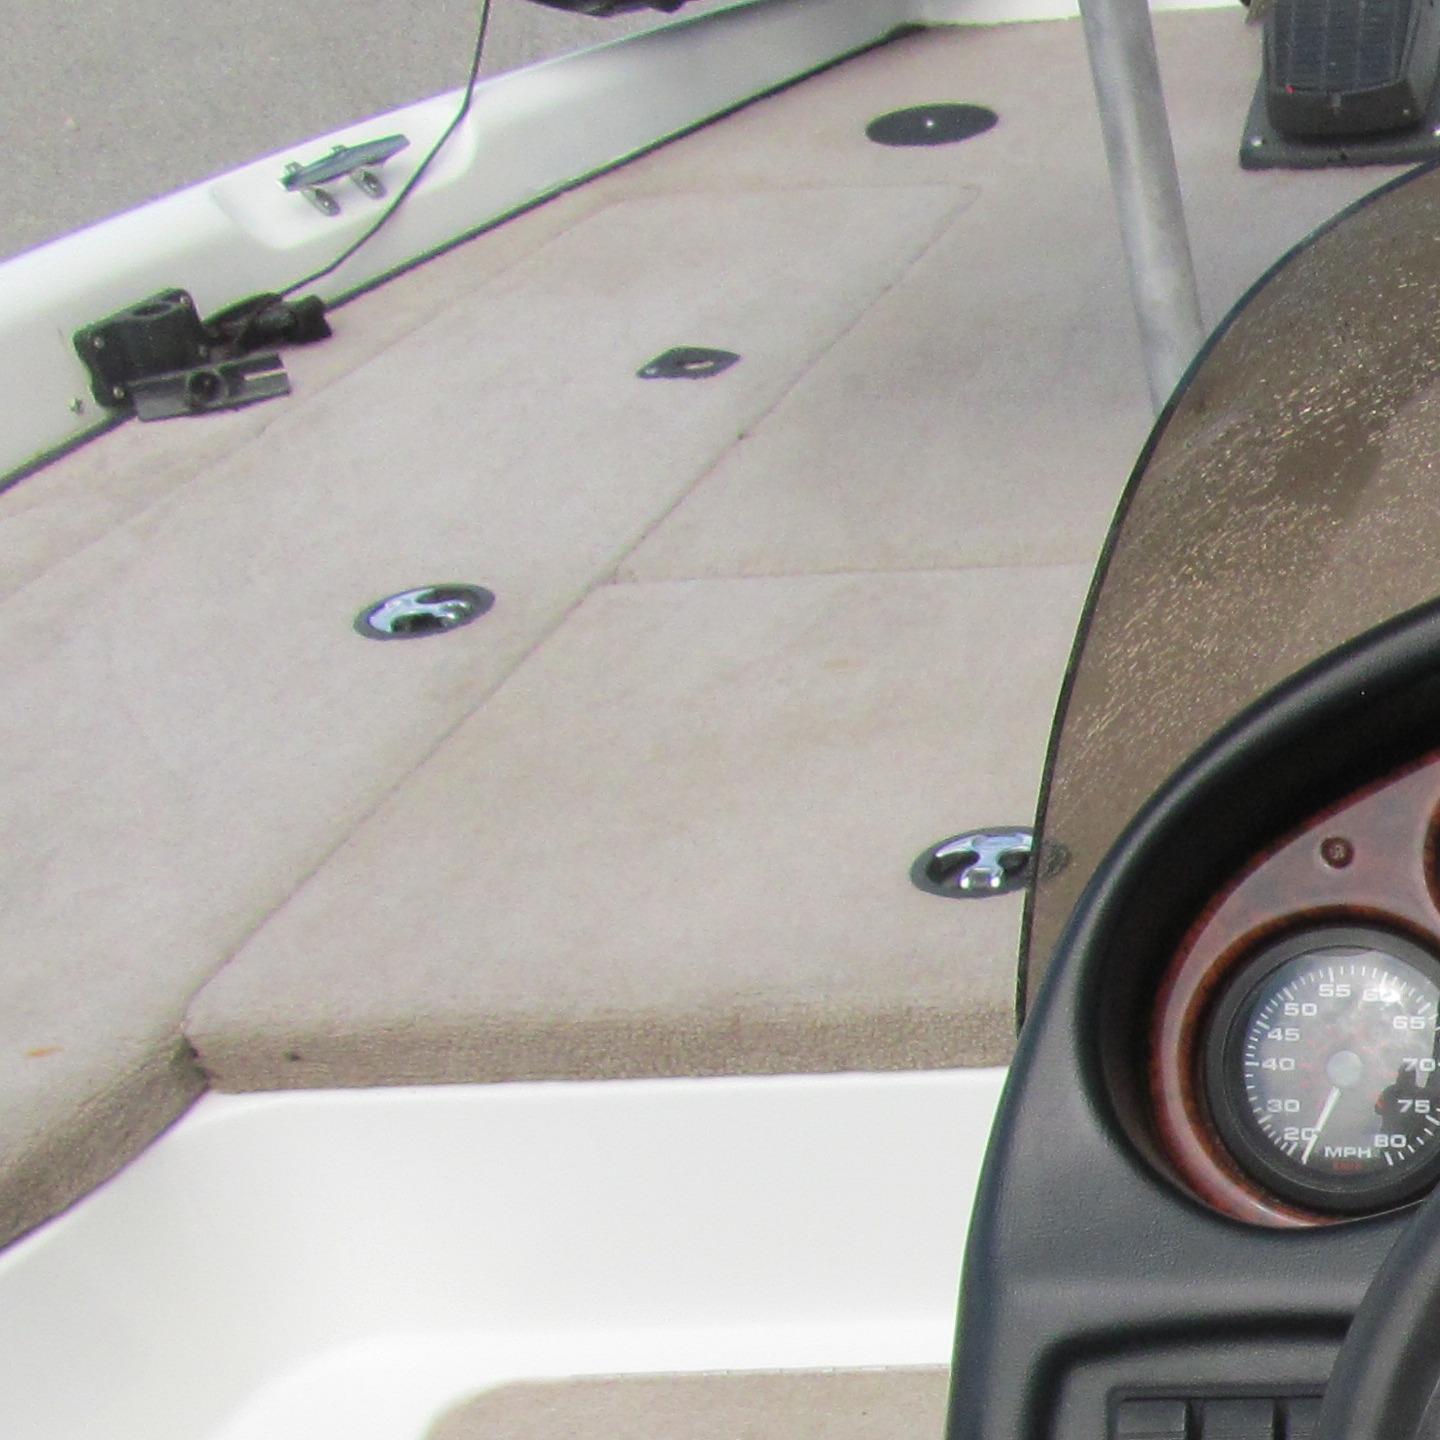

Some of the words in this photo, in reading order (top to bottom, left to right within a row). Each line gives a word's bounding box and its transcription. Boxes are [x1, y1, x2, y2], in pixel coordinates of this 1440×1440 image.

[1318, 984, 1351, 998] 55
[1284, 1003, 1317, 1017] 50
[1392, 1016, 1426, 1030] 65
[1267, 1028, 1300, 1041] 45
[1261, 1057, 1296, 1071] 40
[1402, 1057, 1436, 1072] 70
[1267, 1099, 1300, 1113] 30
[1398, 1100, 1431, 1114] 75
[1283, 1126, 1318, 1141] 20
[1373, 1134, 1407, 1149] 80
[1324, 1146, 1372, 1159] MPH
